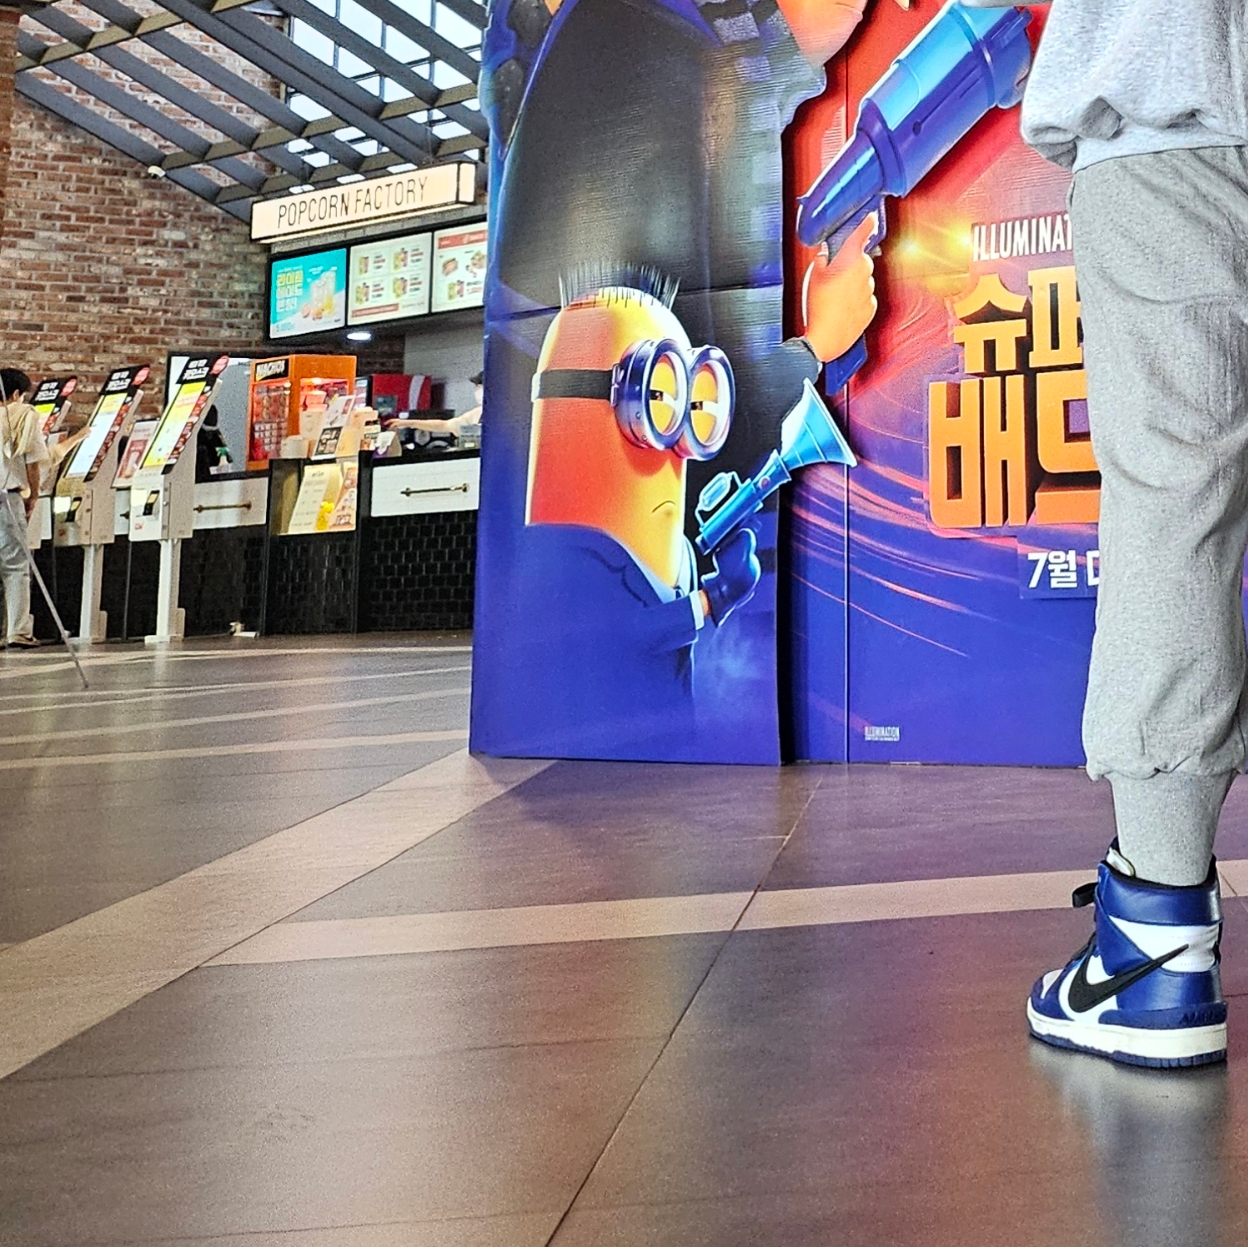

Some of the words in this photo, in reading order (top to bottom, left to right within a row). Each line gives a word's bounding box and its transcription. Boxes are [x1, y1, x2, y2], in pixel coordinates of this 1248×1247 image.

[277, 192, 350, 229] POPCORN
[354, 176, 428, 214] FACTORY
[973, 213, 1073, 262] ILLUMINAT
[1027, 550, 1079, 590] 7월
